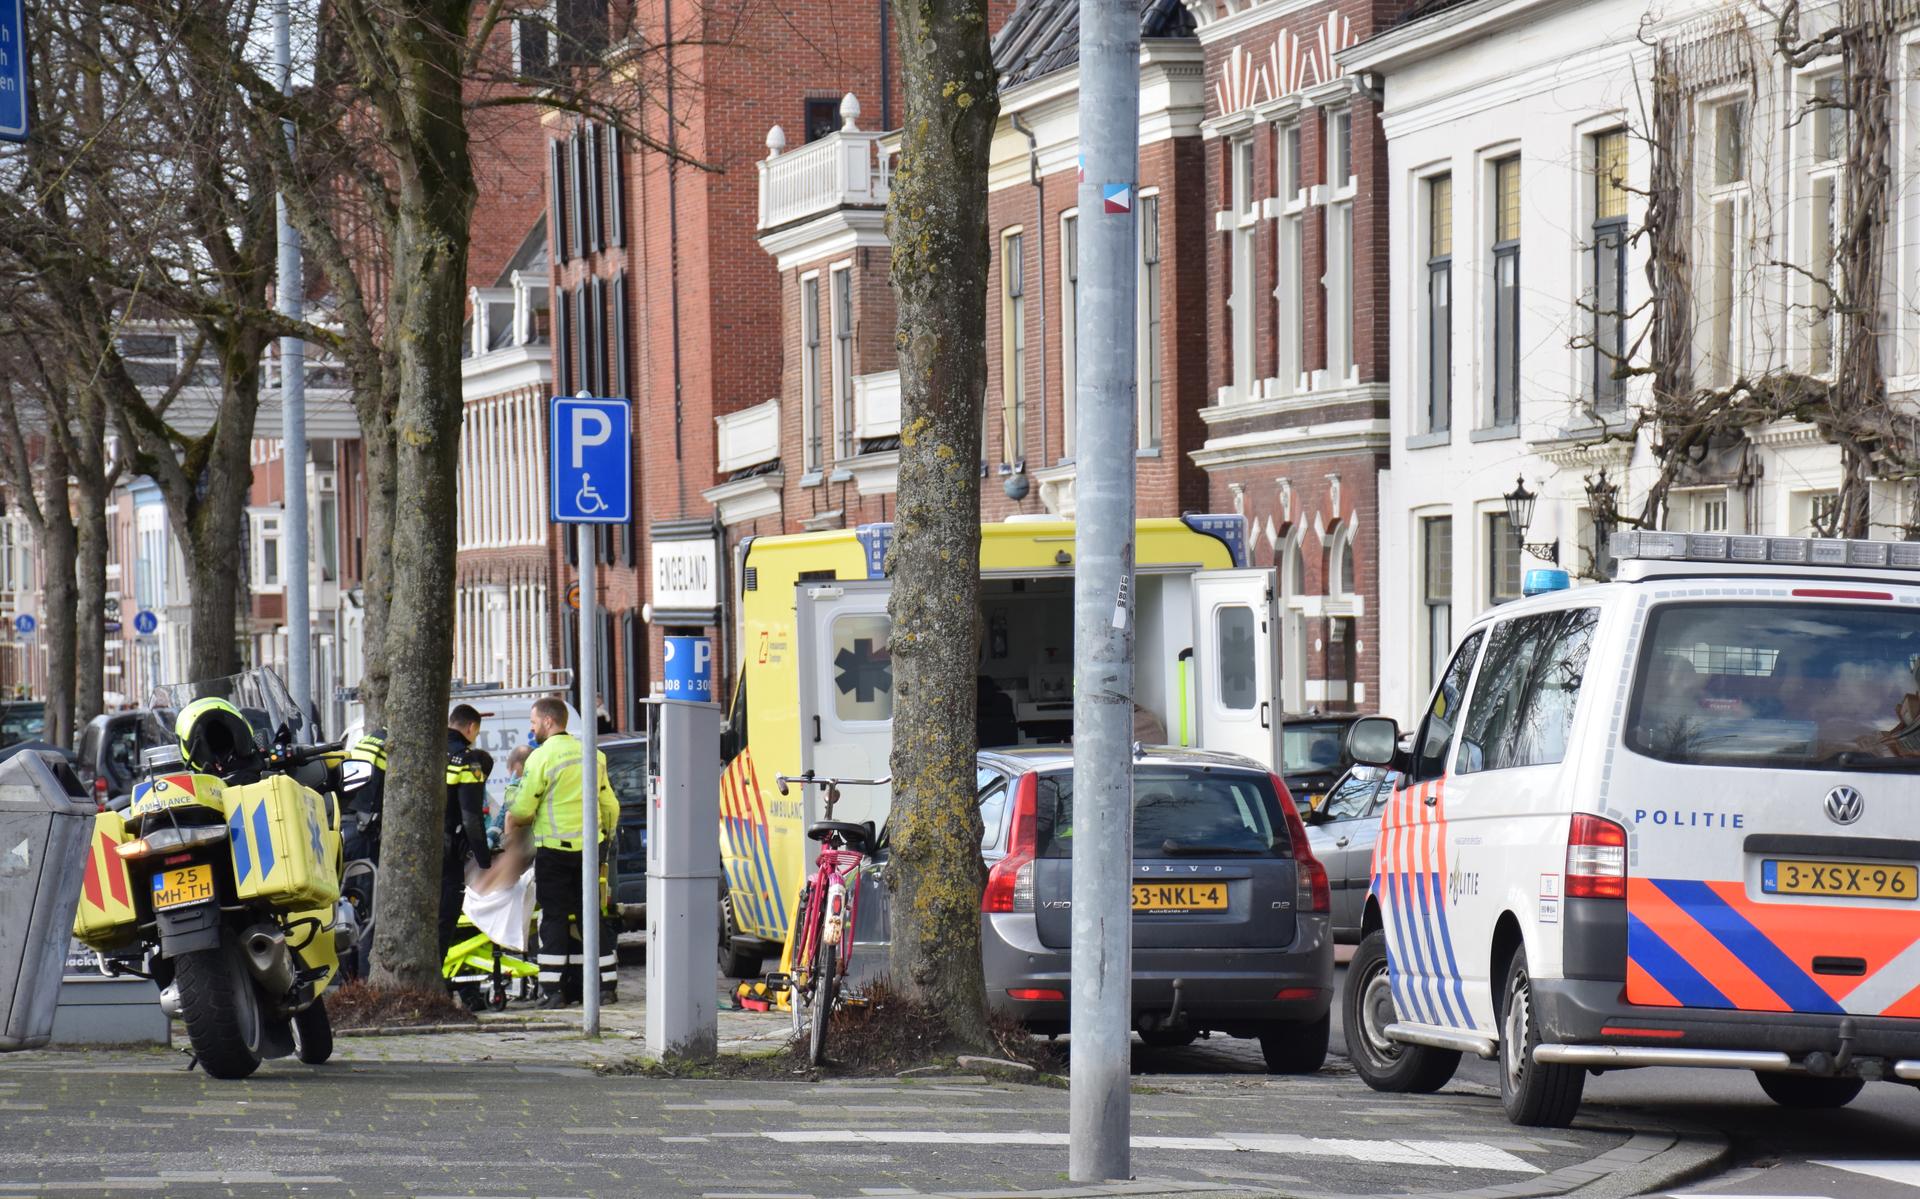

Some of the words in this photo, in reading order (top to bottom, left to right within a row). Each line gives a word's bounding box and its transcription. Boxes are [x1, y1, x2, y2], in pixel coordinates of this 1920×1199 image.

[572, 408, 612, 468] P
[660, 555, 707, 591] ENGELAND
[694, 640, 711, 673] P
[1635, 809, 1744, 828] POLITIE
[176, 869, 198, 886] 25
[1765, 879, 1776, 887] NL
[1786, 866, 1906, 893] 3-XSX-96
[155, 882, 211, 905] MH-TH
